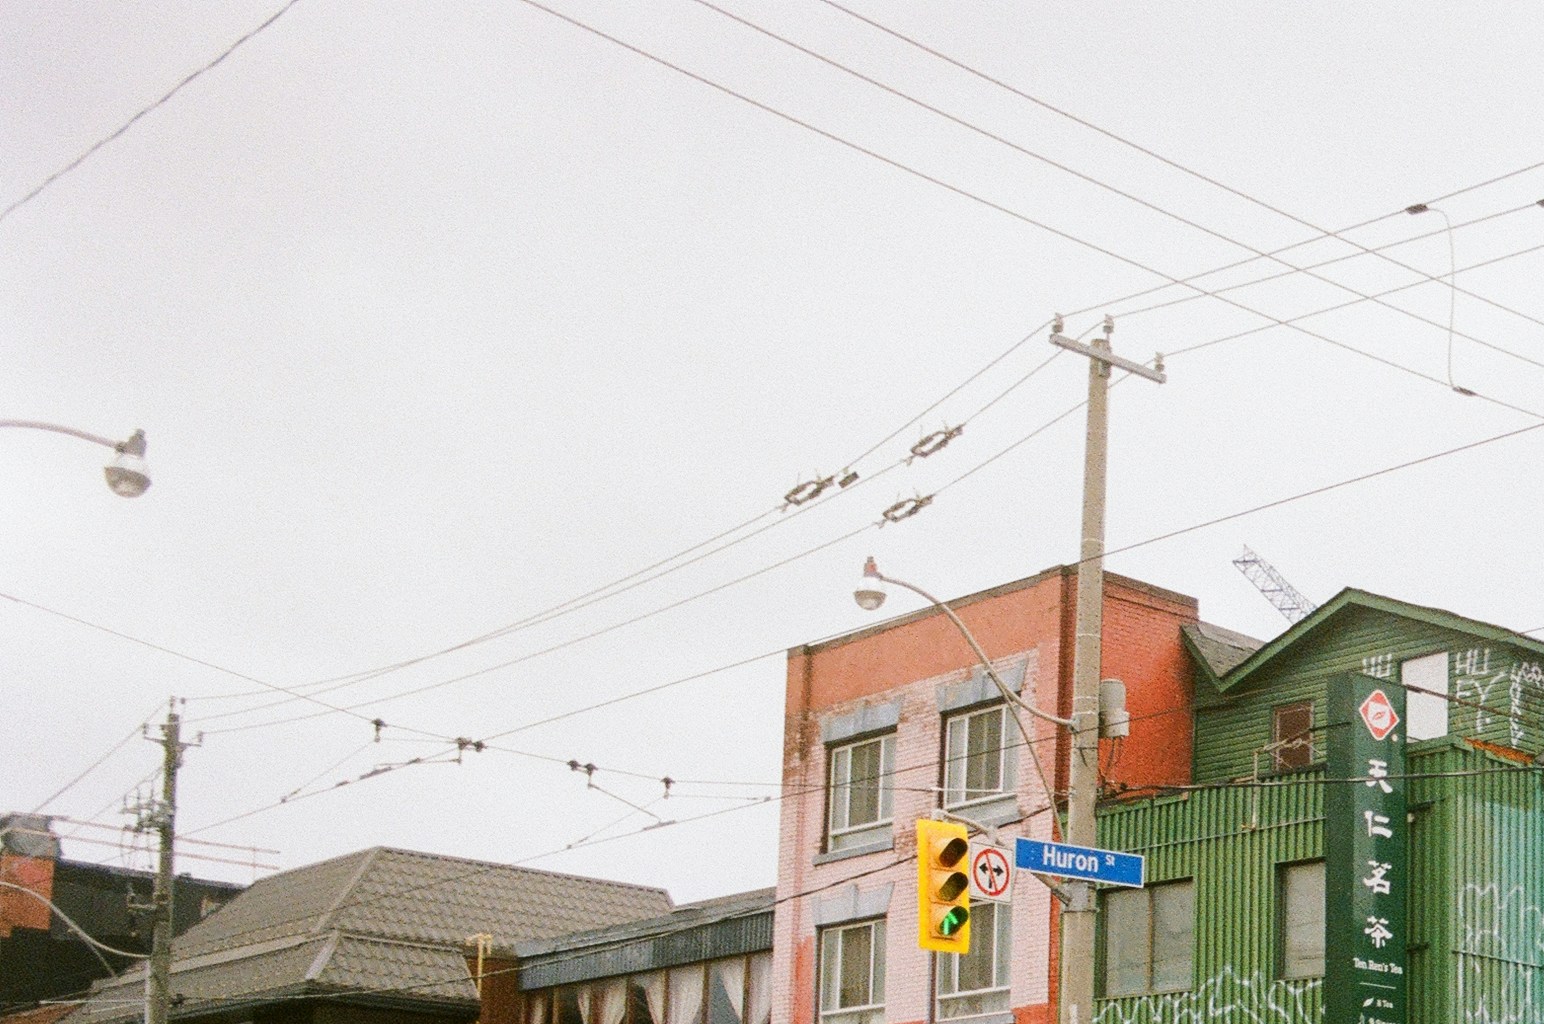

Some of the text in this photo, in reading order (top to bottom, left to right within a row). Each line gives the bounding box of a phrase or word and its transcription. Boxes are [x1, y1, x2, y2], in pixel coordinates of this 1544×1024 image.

[1042, 844, 1099, 873] Huron
[1363, 758, 1395, 949] 天仁茗茶
[1353, 957, 1367, 970] Ten
[1389, 963, 1403, 975] Tea
